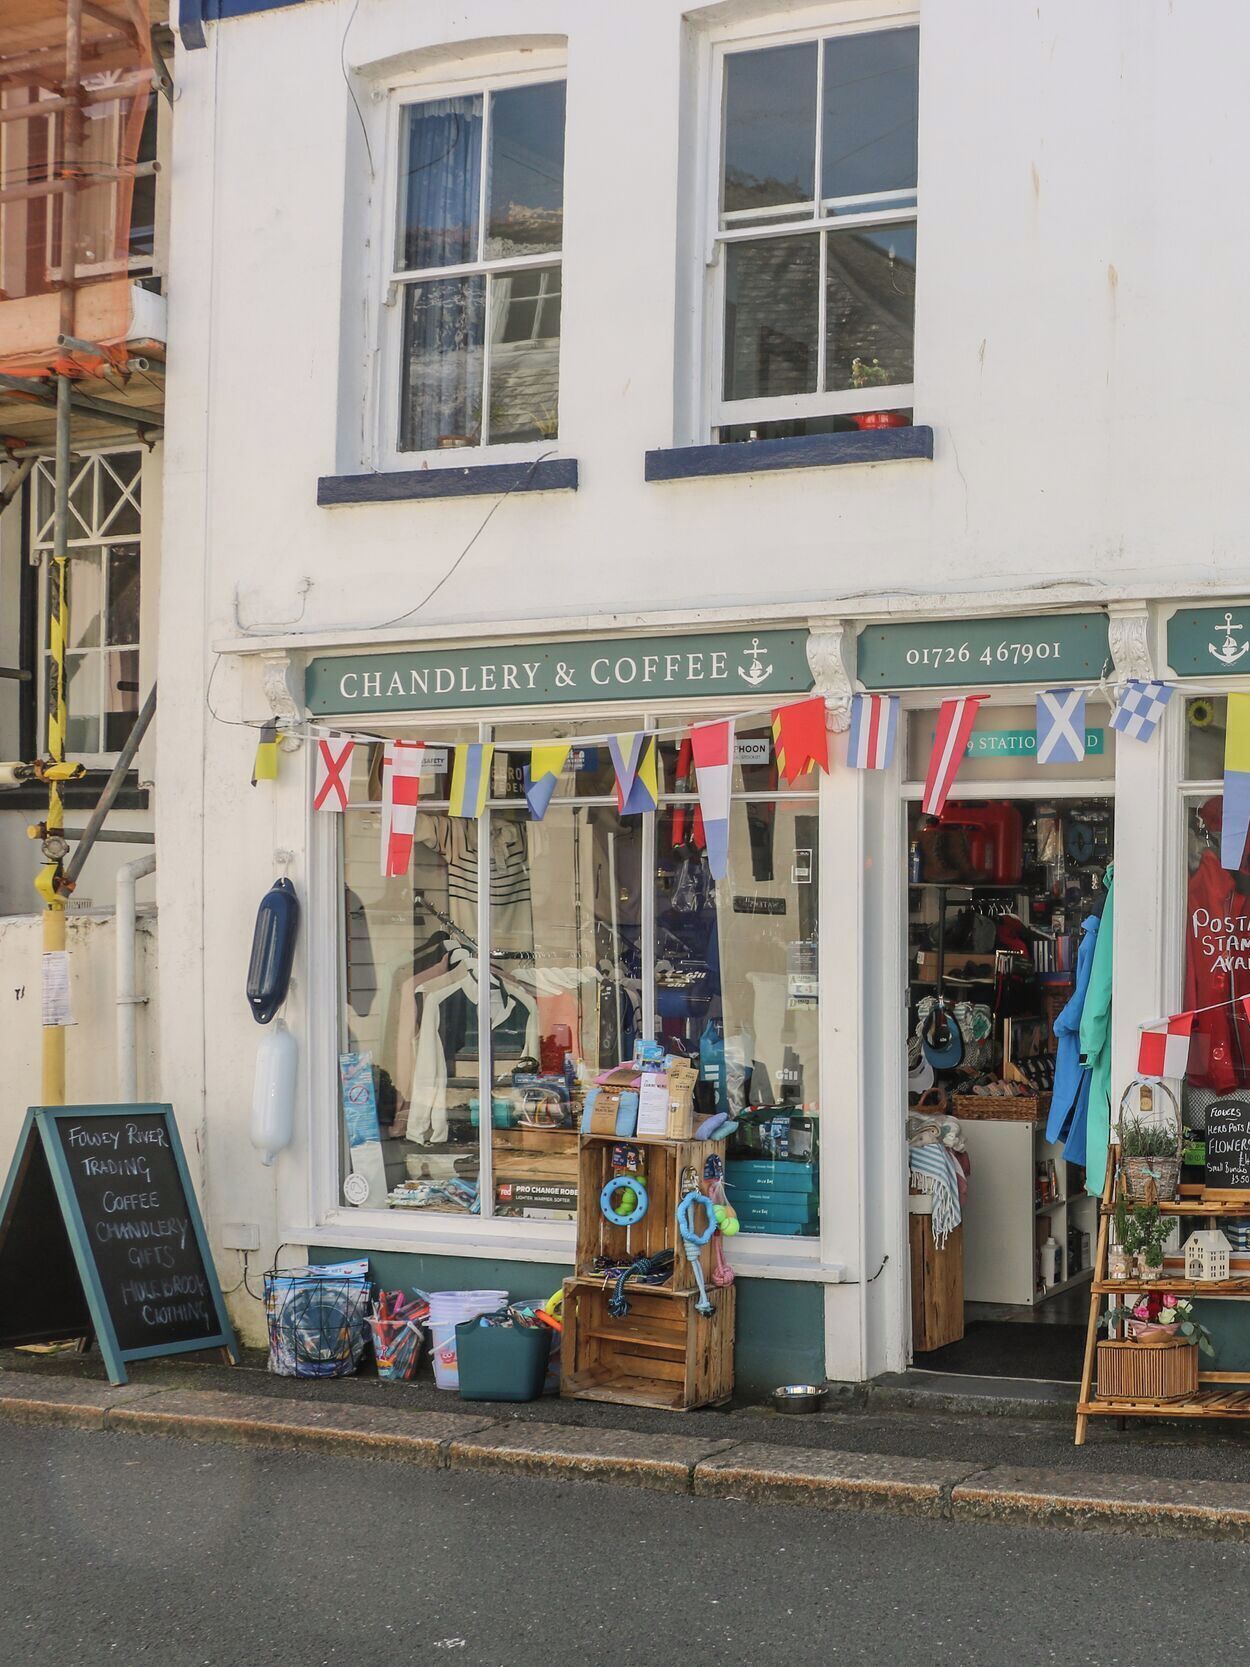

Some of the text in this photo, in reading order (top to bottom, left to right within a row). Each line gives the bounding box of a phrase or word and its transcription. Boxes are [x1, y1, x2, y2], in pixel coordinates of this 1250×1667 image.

[906, 640, 1061, 669] 01726 467901
[339, 651, 729, 699] CHANDLERY & COFFEE
[733, 744, 766, 753] PHOON
[979, 735, 1036, 750] STATIO
[776, 1068, 798, 1081] Gill
[68, 1123, 170, 1150] FOWEY RIVER
[1207, 1124, 1228, 1136] HERB
[1228, 1122, 1245, 1133] POTS
[80, 1156, 151, 1183] TRADING
[102, 1190, 160, 1213] COFFEE
[515, 1185, 531, 1193] PRO
[531, 1186, 560, 1195] CHANGE
[95, 1217, 189, 1250] CHANDLERY
[128, 1246, 176, 1269] GIFTS
[142, 1301, 211, 1331] CLOTHING
